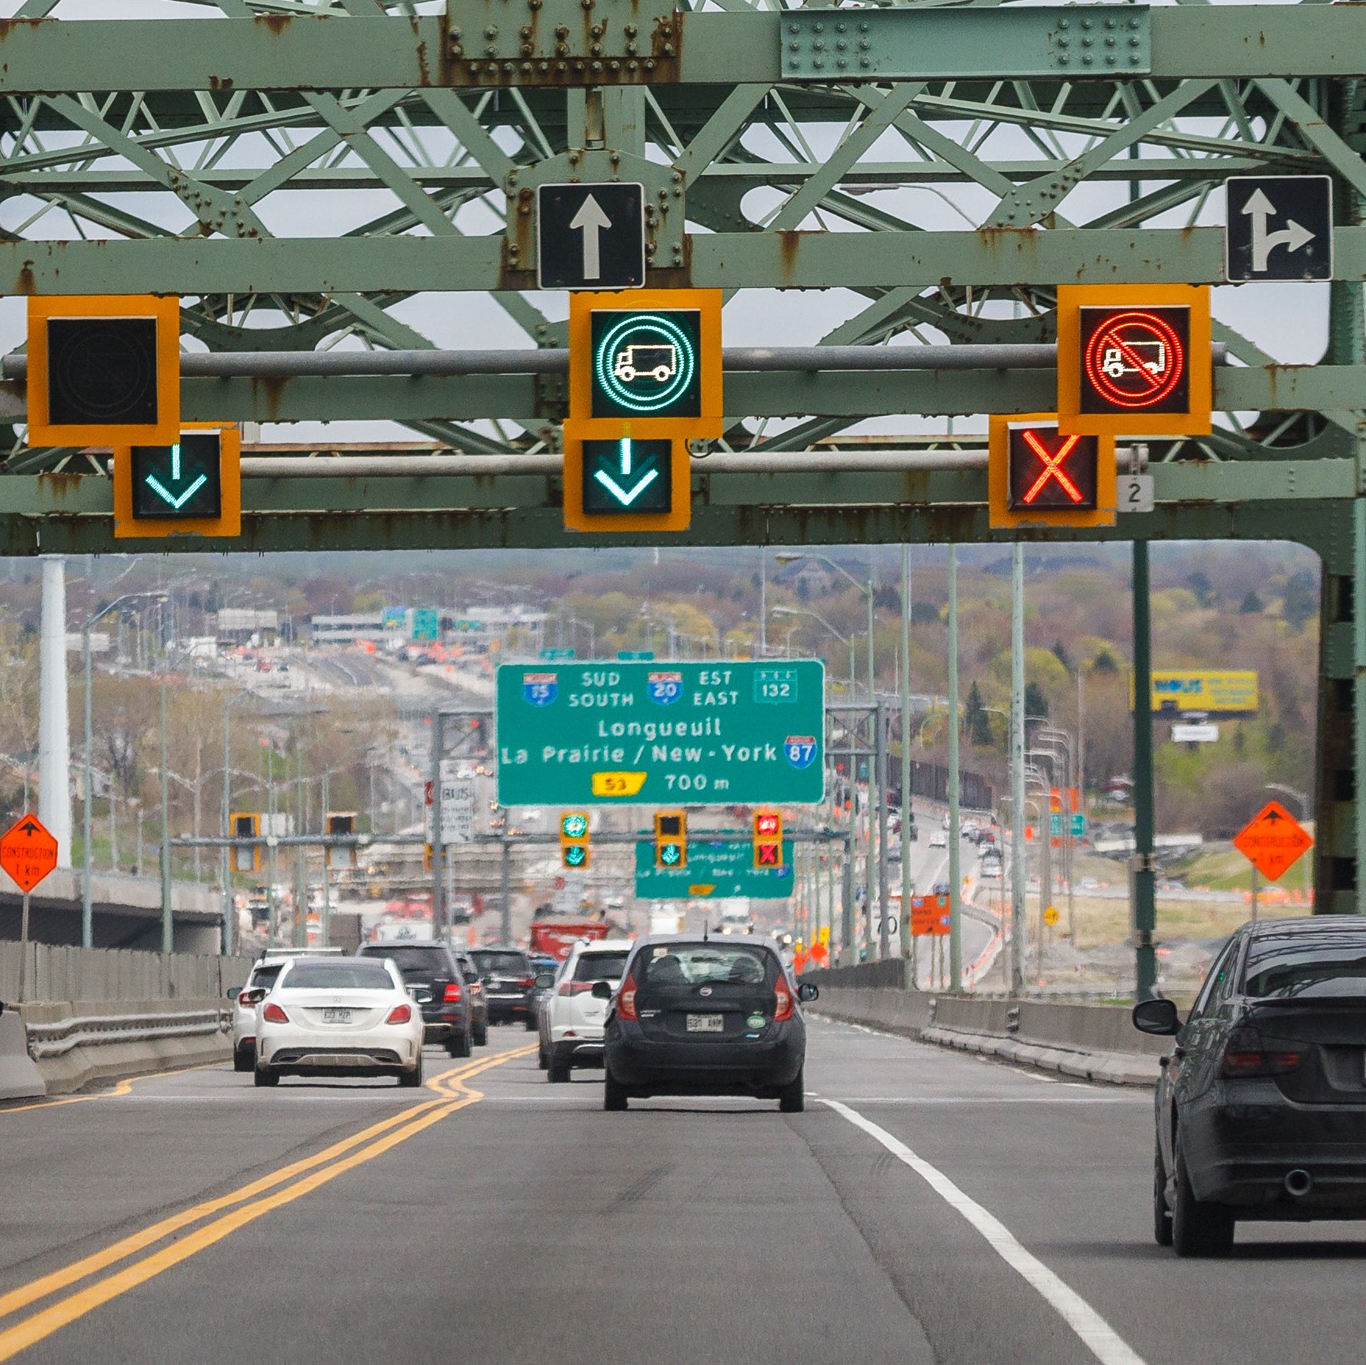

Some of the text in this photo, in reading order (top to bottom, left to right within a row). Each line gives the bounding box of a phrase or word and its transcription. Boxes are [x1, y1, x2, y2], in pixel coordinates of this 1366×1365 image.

[1129, 483, 1141, 502] 2
[581, 672, 620, 687] SUD
[699, 671, 732, 685] EST
[654, 683, 677, 697] 20
[762, 684, 790, 697] 132
[569, 693, 634, 707] SOUTH
[693, 691, 738, 706] EAST
[598, 718, 721, 741] Longueuil
[501, 747, 528, 764] La
[542, 744, 625, 763] Prairie
[789, 745, 813, 762] 87
[665, 775, 707, 790] 700
[714, 778, 730, 790] m
[3, 846, 54, 859] CONSTRUCTION
[25, 864, 40, 876] km
